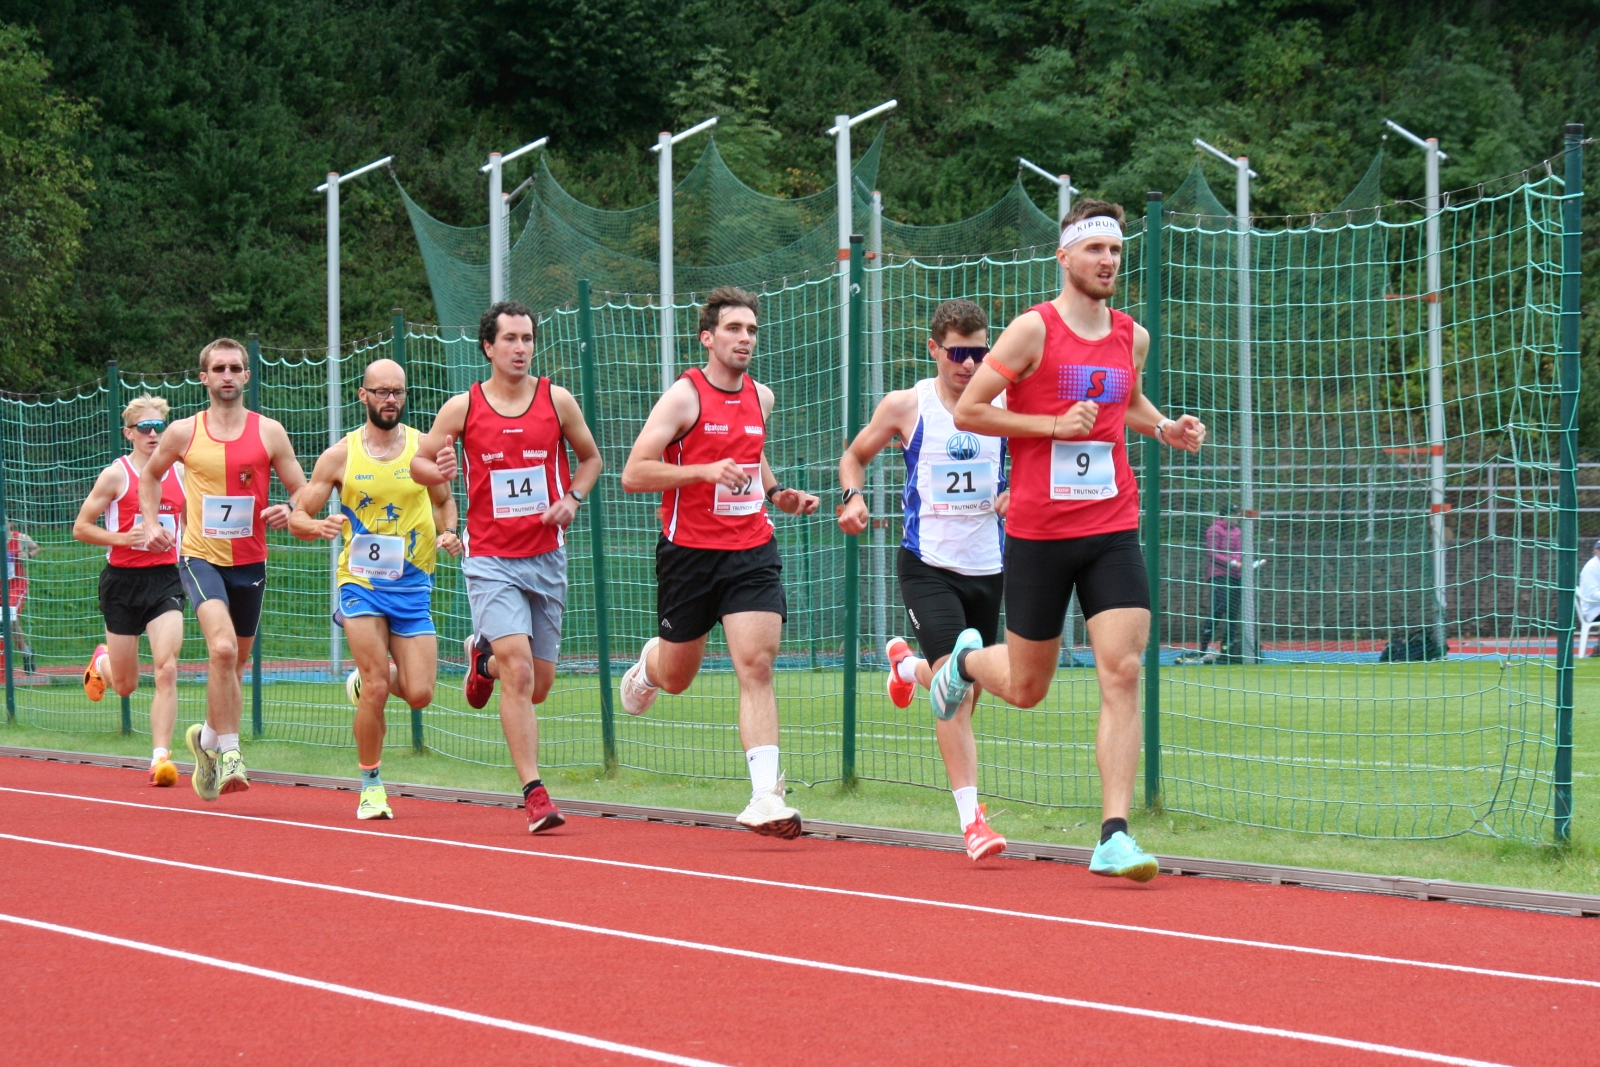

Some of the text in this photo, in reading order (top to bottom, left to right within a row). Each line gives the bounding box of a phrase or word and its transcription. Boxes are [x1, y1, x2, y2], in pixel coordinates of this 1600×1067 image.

[1077, 221, 1116, 232] KIPRUN
[1086, 371, 1107, 398] S
[1076, 452, 1090, 476] 9
[506, 477, 533, 498] 14
[946, 471, 976, 493] 21
[220, 504, 232, 522] 7
[368, 543, 380, 561] 8
